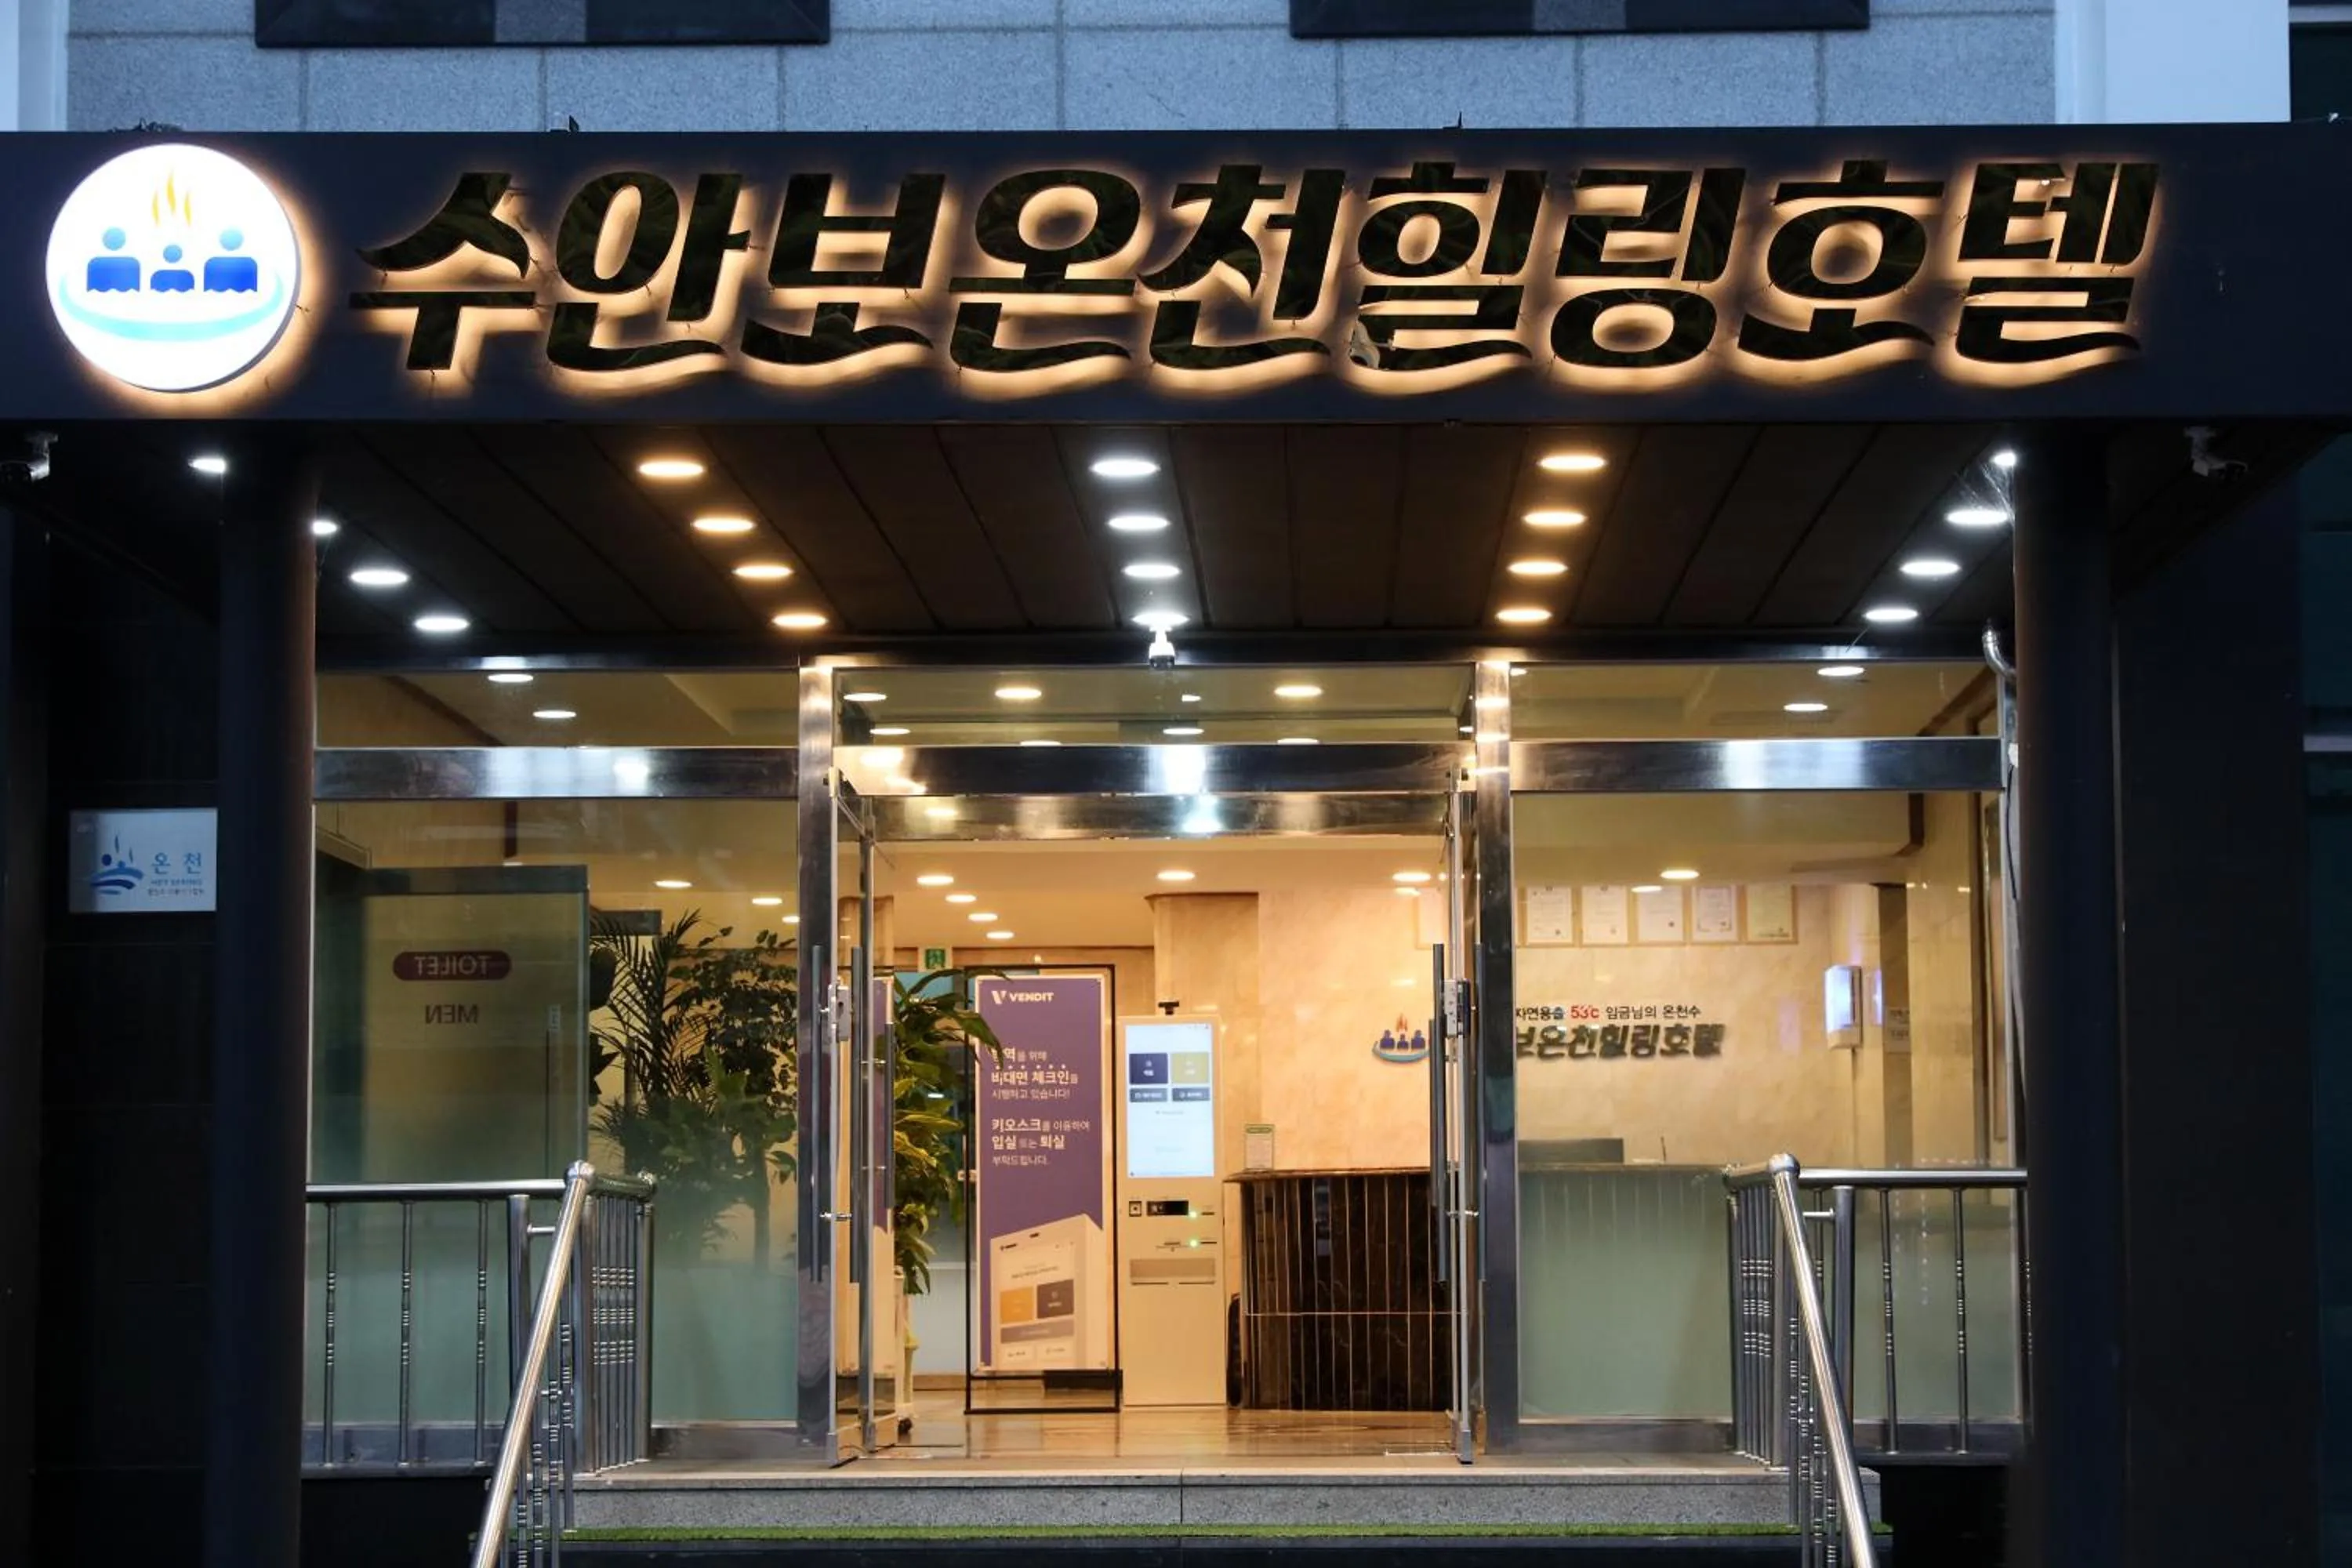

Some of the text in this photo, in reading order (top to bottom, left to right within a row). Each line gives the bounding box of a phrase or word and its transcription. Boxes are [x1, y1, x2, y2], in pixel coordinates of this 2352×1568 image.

[349, 159, 2161, 372] 수안보온천힐링호텔
[1009, 992, 1054, 1002] VENDIT
[1606, 1005, 1657, 1020] 임금님의
[1662, 1004, 1702, 1019] 온천수
[991, 1070, 1028, 1086] 비대면
[992, 1134, 1017, 1150] 입실
[1040, 1134, 1065, 1150] 퇴실
